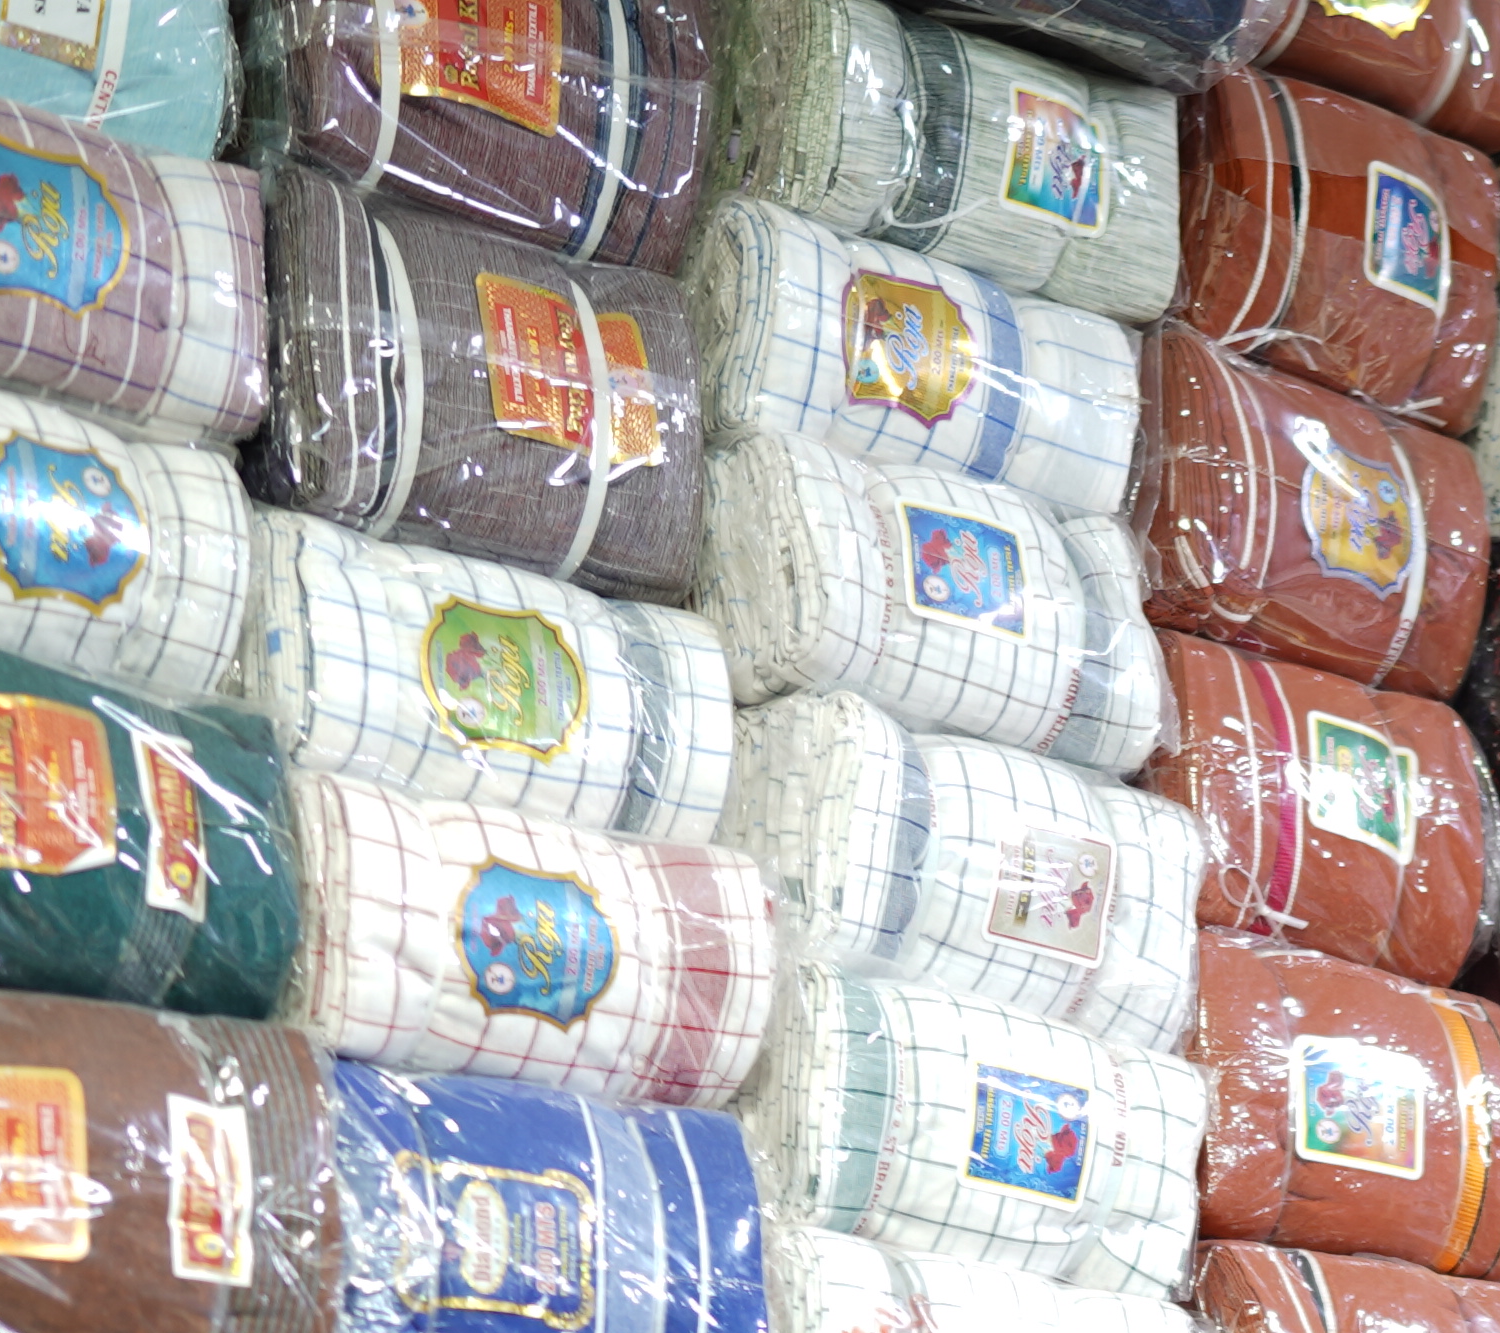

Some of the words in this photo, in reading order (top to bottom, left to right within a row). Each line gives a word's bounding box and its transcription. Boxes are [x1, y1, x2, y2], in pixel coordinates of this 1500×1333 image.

[22, 182, 69, 278] Roja
[887, 302, 930, 390] Roja
[950, 529, 988, 608] Roja
[487, 634, 530, 724] Roja
[517, 898, 562, 995] Roja
[1001, 1100, 1012, 1127] 2.00
[1013, 1092, 1051, 1175] Roja
[1110, 1131, 1127, 1168] NDIA
